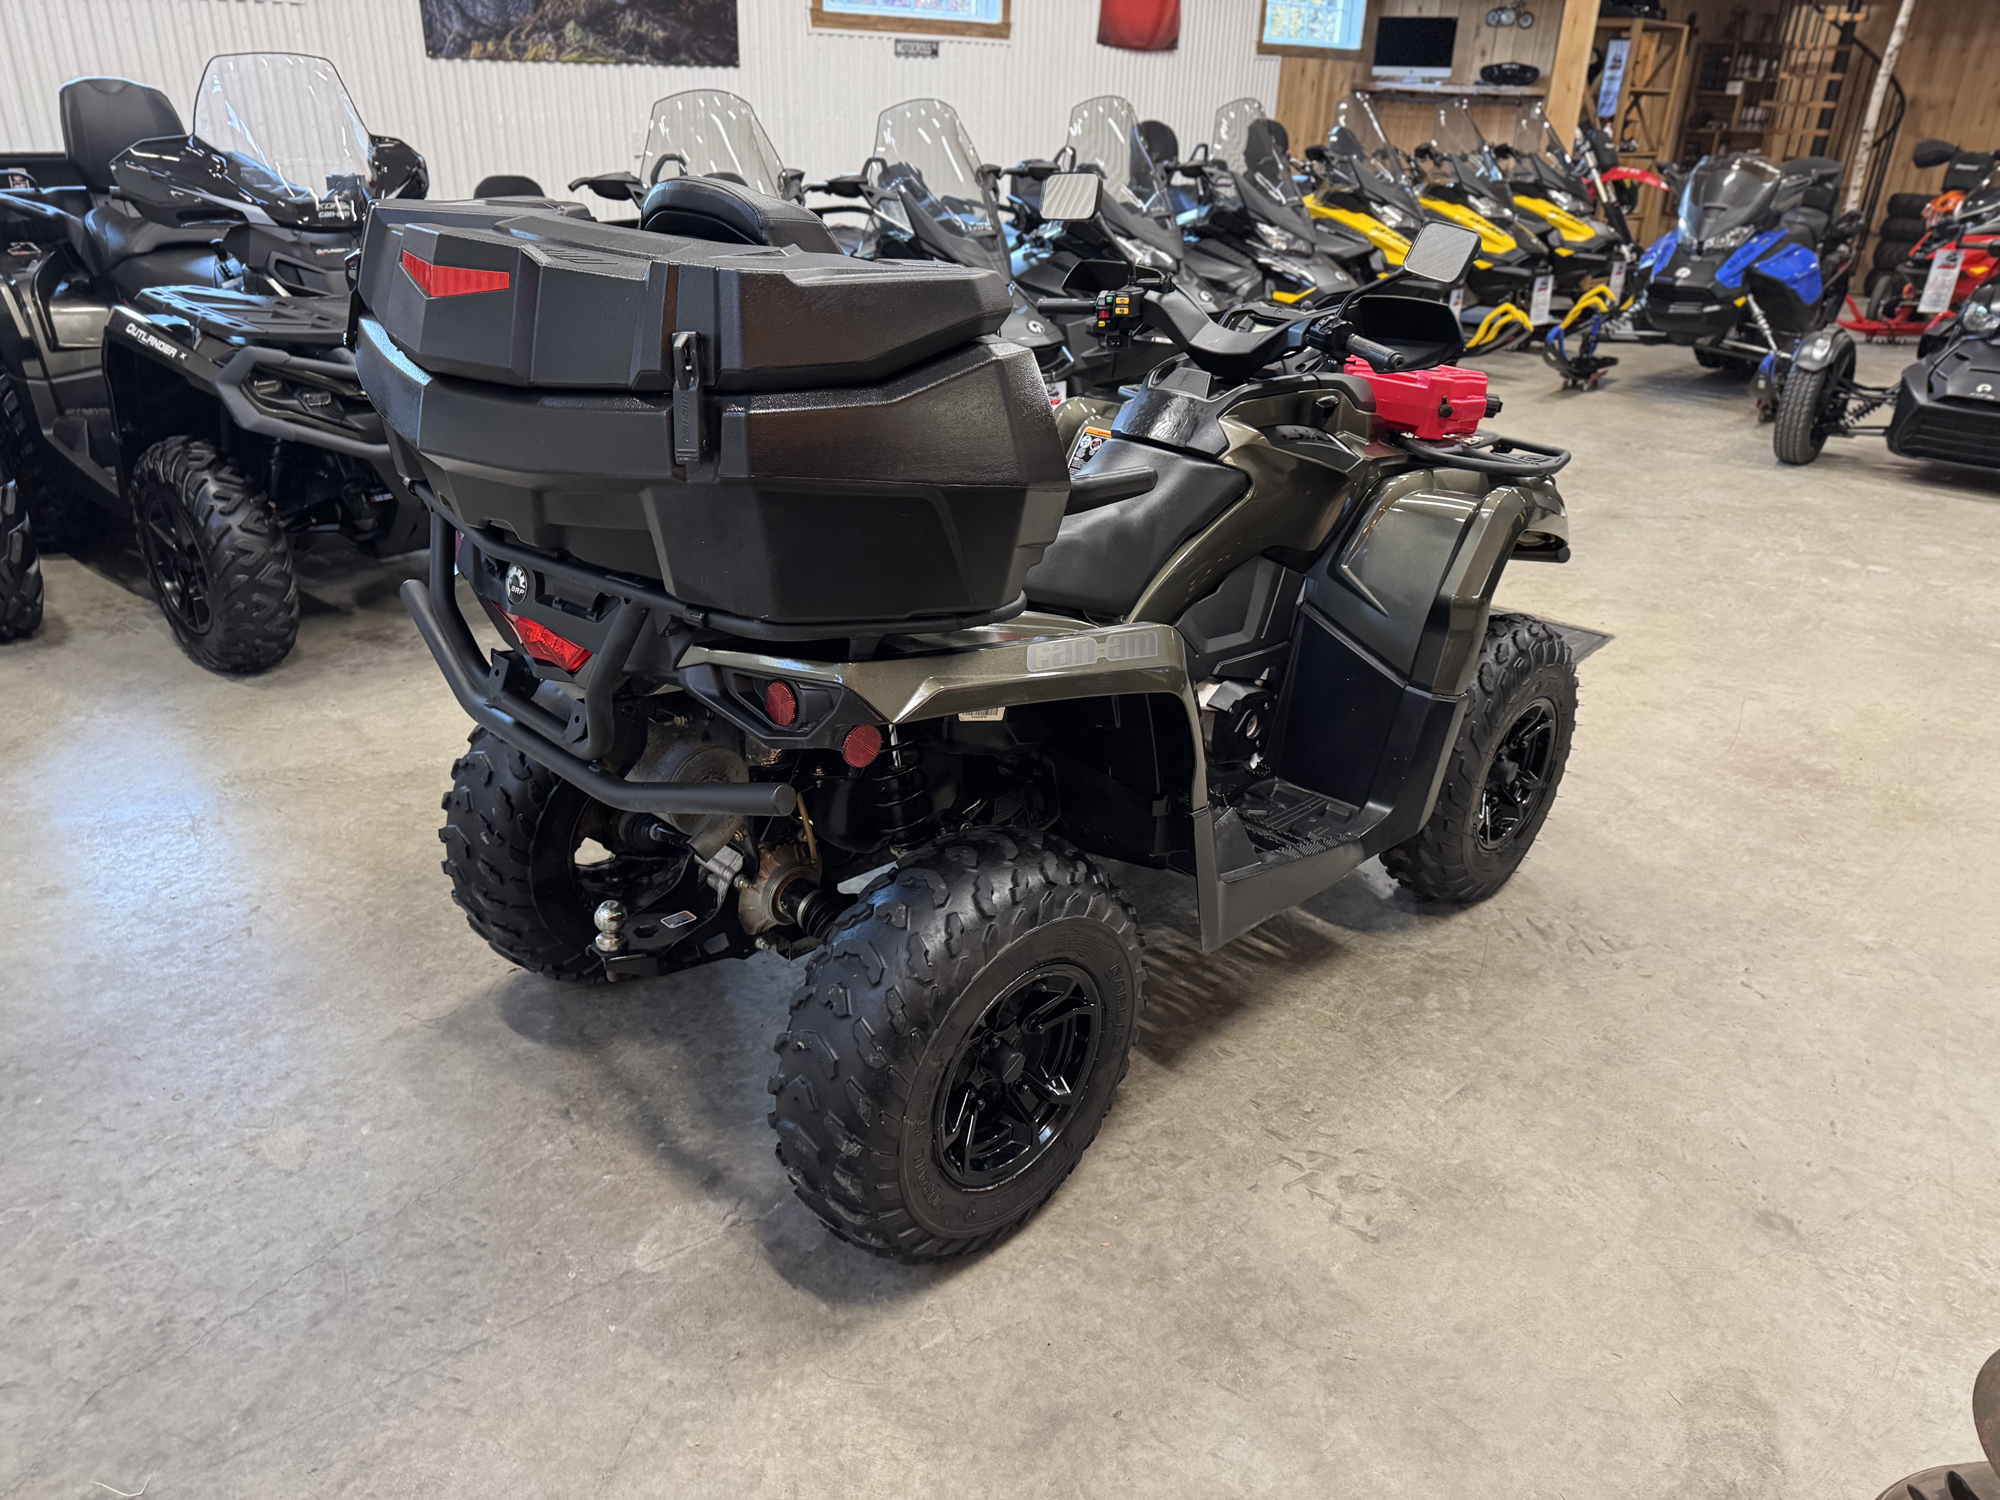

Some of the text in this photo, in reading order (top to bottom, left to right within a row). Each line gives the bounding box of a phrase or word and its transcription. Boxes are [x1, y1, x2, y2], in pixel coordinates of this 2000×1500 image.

[125, 322, 178, 358] OUTLANDER
[510, 585, 525, 595] BRP
[1028, 632, 1158, 672] can-am
